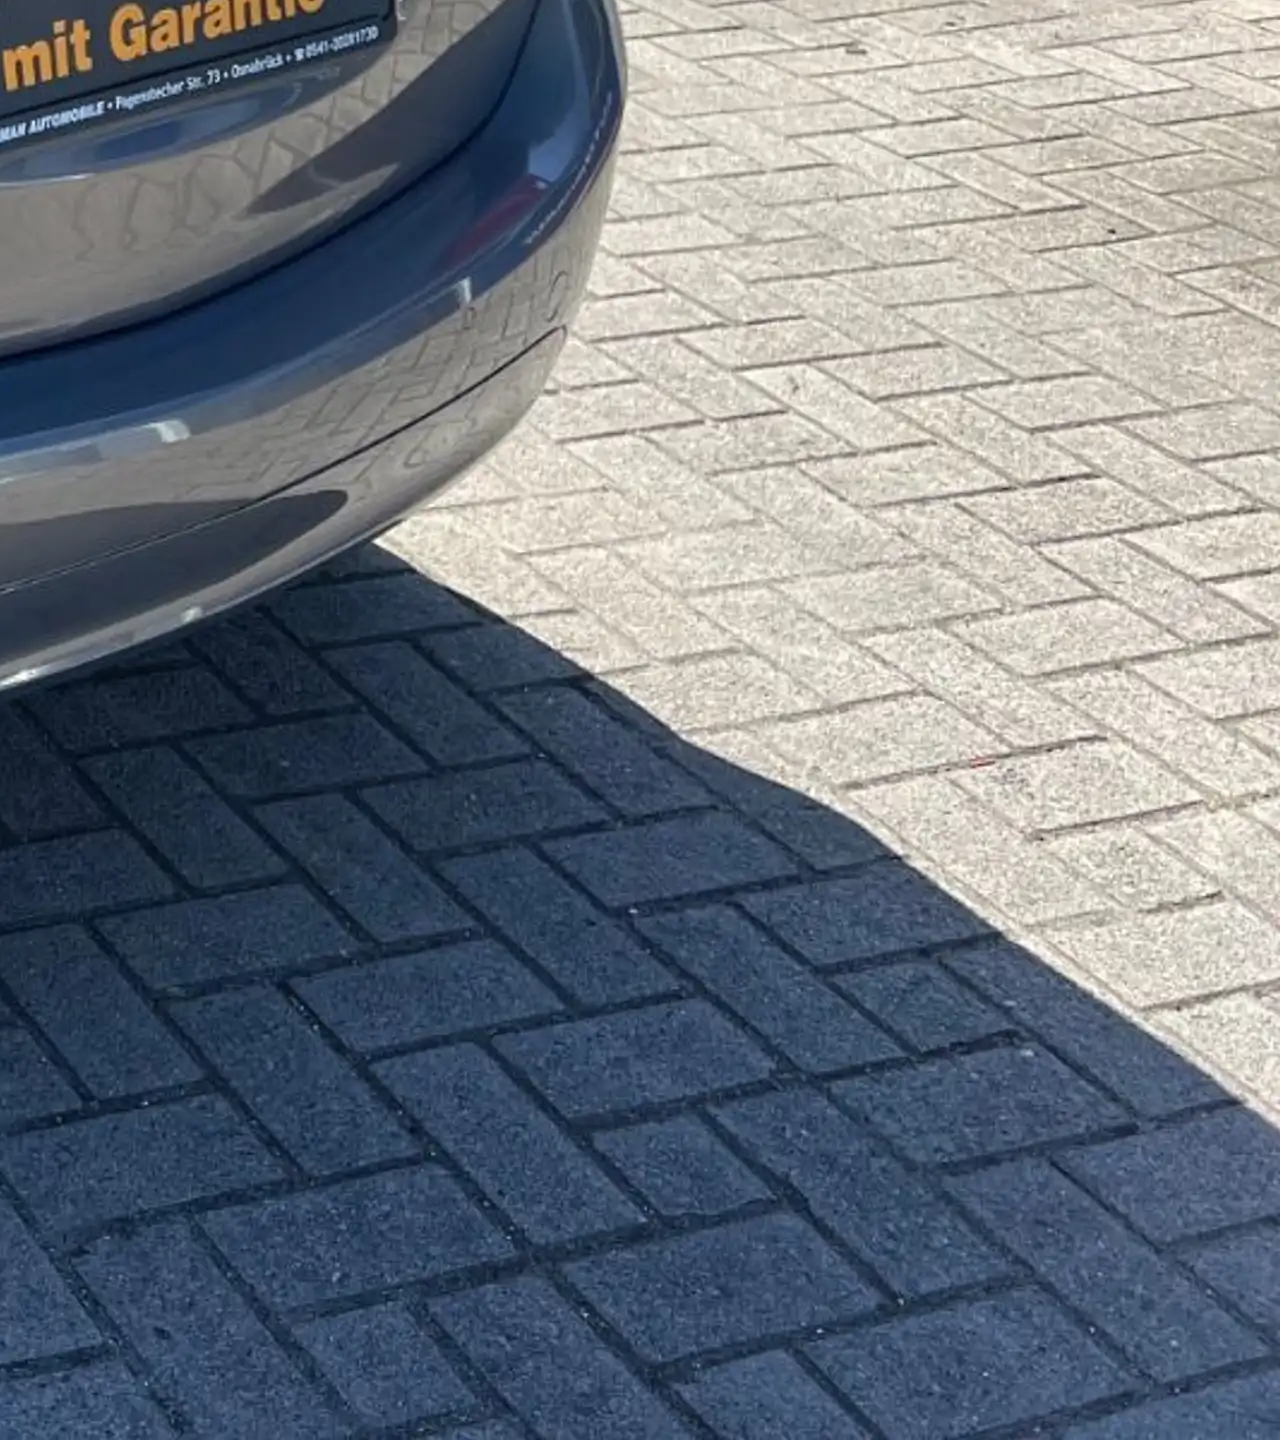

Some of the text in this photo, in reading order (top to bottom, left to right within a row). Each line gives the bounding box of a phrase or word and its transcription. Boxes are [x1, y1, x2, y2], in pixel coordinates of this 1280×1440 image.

[1, 18, 93, 92] mit
[27, 101, 106, 135] AUTOMOBILE
[206, 68, 221, 85] 73
